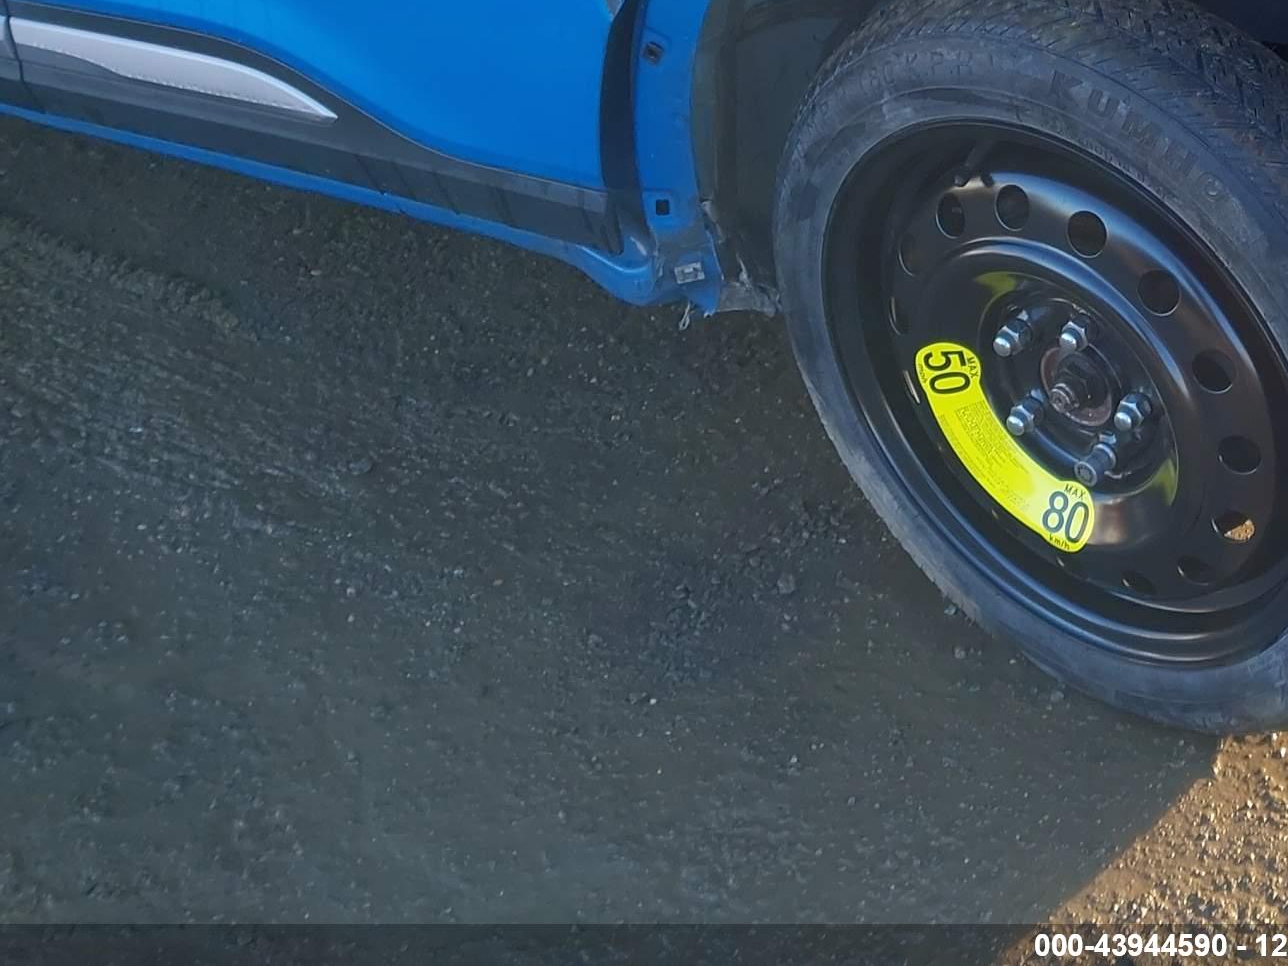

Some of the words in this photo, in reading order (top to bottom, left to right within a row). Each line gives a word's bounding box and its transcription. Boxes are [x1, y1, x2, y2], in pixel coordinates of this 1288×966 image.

[1050, 69, 1231, 204] KUMHO
[923, 350, 971, 395] 50
[967, 356, 979, 379] MAX
[1064, 483, 1087, 500] MAX
[1042, 490, 1090, 544] 80
[1049, 533, 1071, 550] km/h
